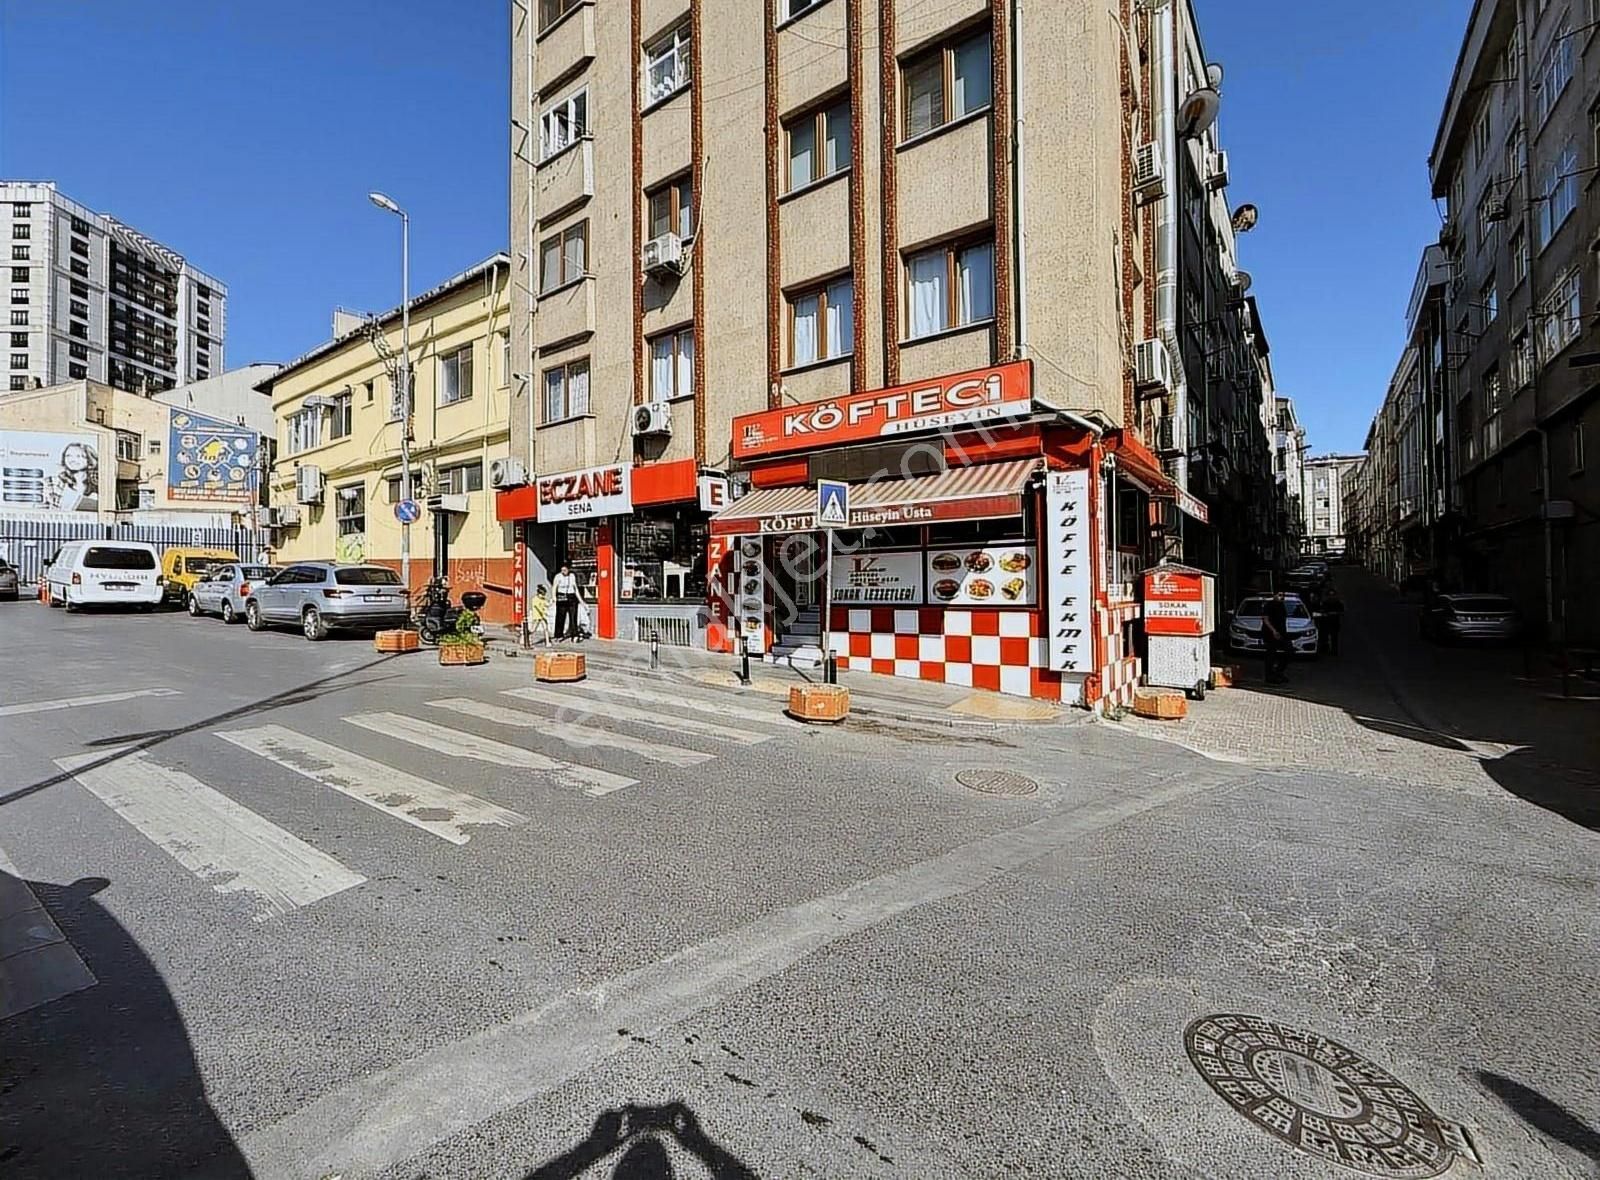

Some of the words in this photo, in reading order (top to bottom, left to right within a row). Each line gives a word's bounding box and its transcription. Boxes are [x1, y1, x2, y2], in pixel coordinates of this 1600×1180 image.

[539, 467, 624, 506] ECZANE
[710, 483, 723, 505] E
[567, 502, 593, 516] SENA
[851, 509, 899, 524] Hüseyin
[903, 505, 932, 519] Usta
[514, 526, 523, 613] ECZANE
[710, 543, 722, 616] ZANE
[1055, 597, 1082, 670] EKMEK
